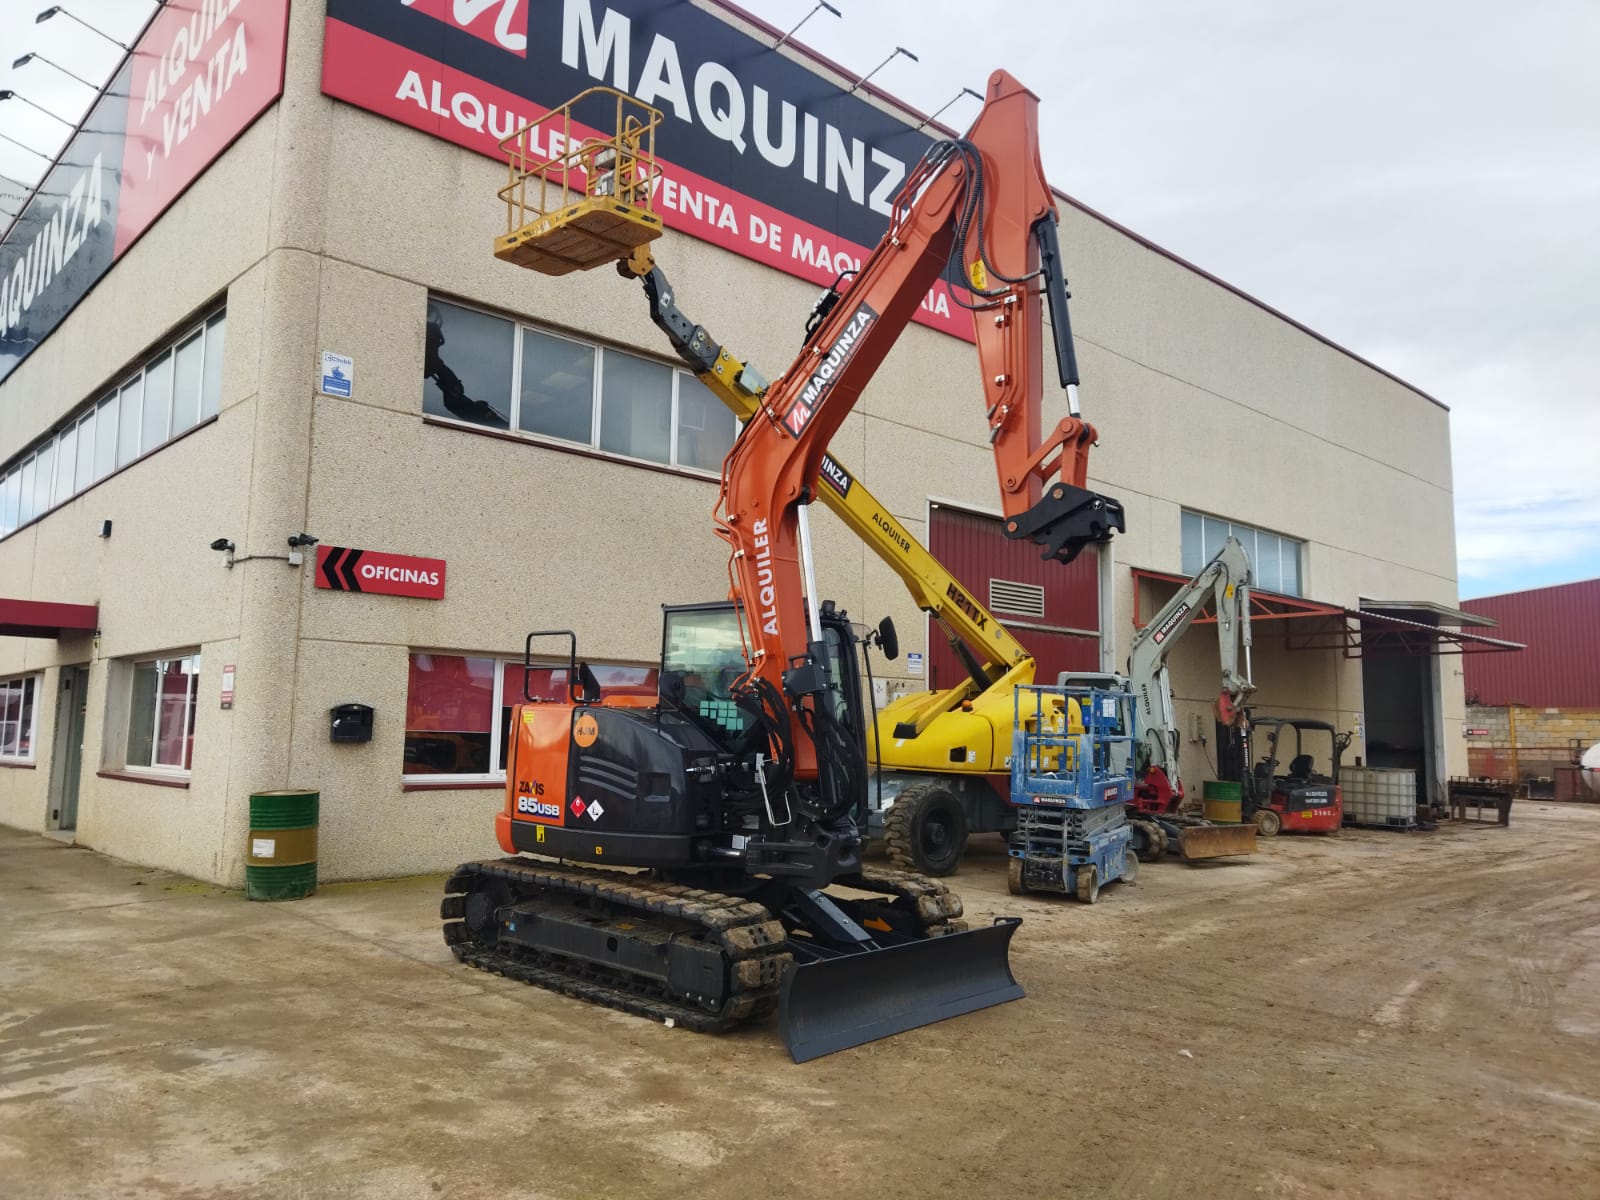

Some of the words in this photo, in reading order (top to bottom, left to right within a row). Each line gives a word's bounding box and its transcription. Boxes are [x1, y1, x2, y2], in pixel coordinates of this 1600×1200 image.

[140, 0, 241, 126] ALQUIL
[147, 144, 157, 181] Y
[163, 22, 248, 160] VENTA
[561, 0, 914, 224] MAQUINZ
[637, 166, 739, 235] VENTA
[750, 214, 782, 252] DE
[802, 311, 871, 405] MAQUINZA
[361, 564, 439, 586] OFICINAS
[753, 517, 779, 636] ALQUILER
[871, 512, 912, 553] ALQUILER
